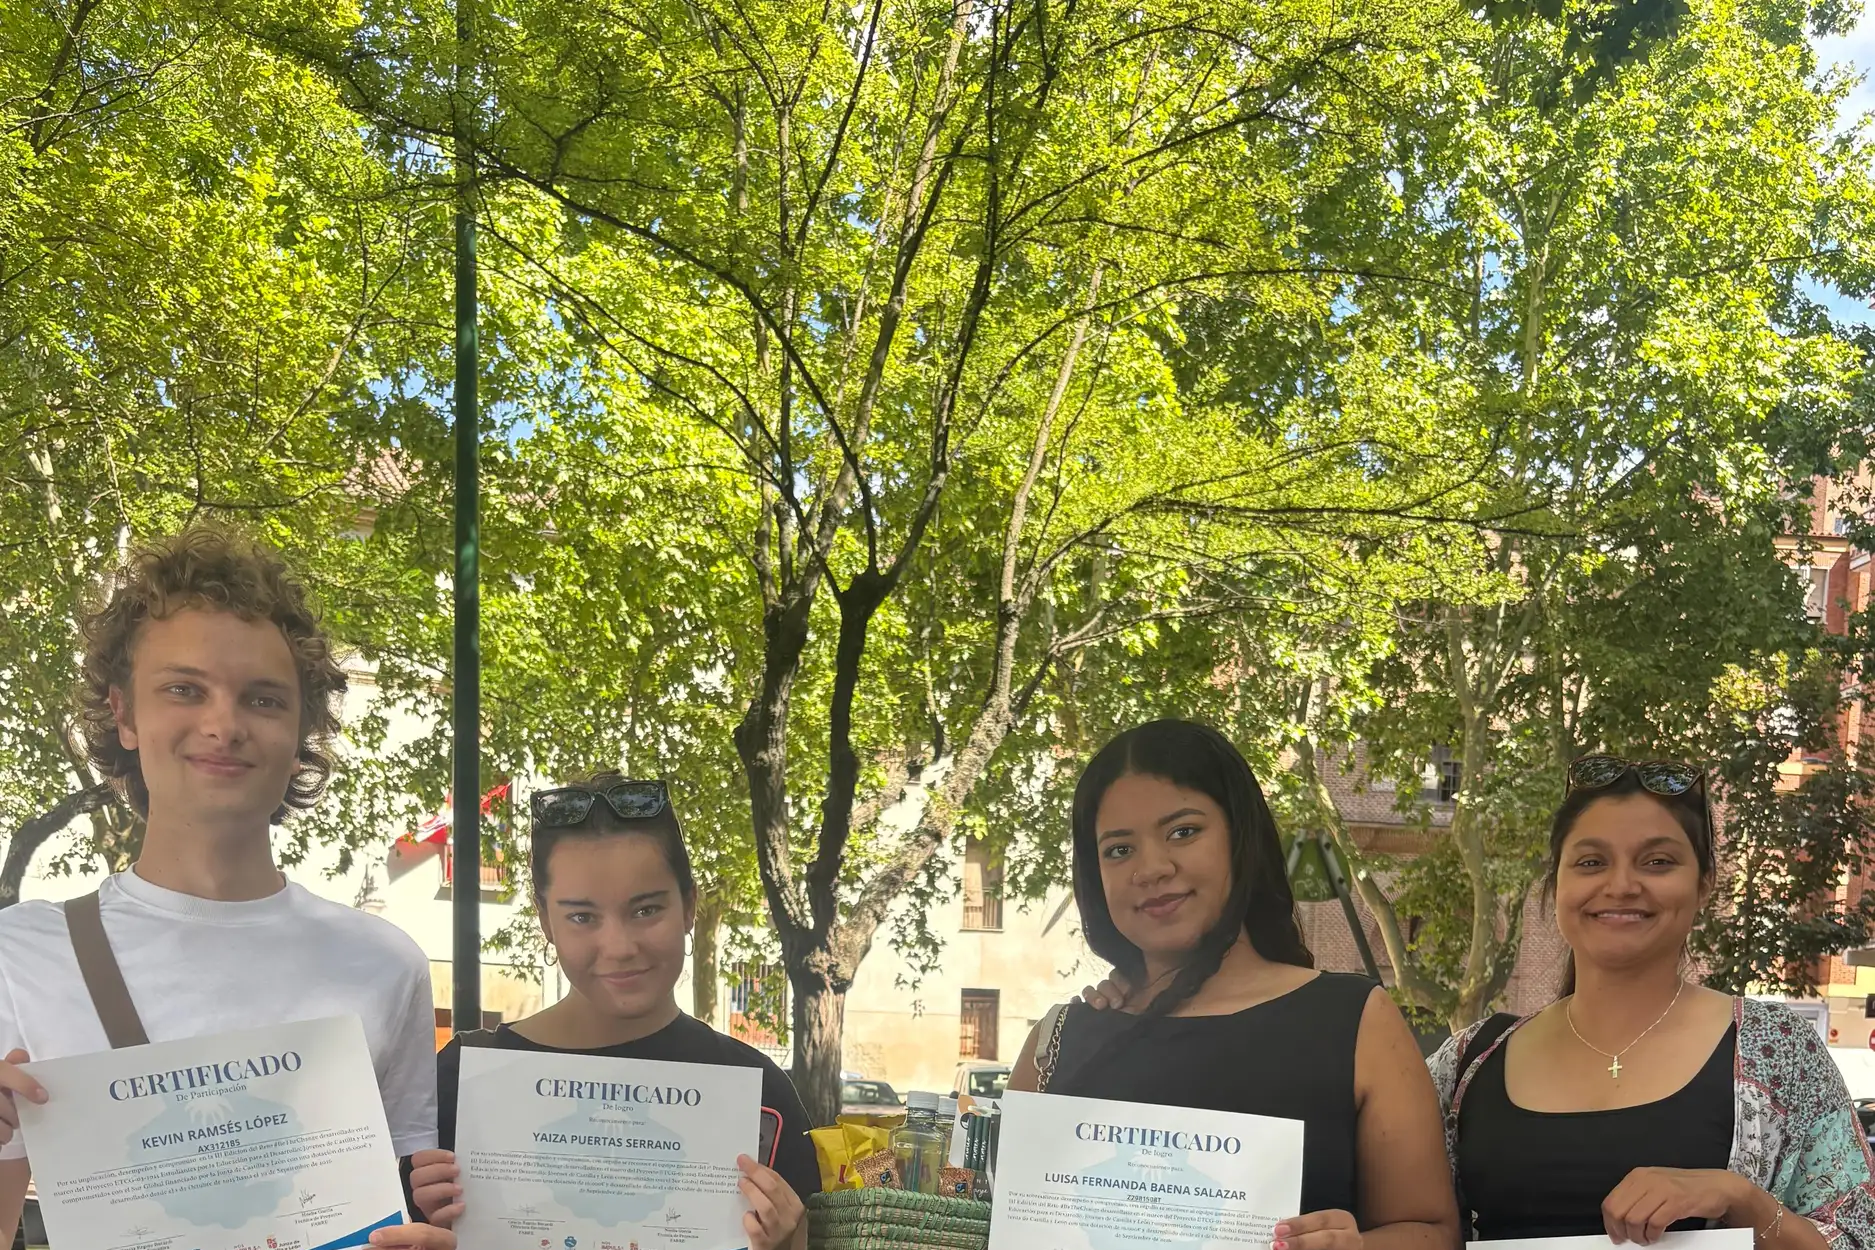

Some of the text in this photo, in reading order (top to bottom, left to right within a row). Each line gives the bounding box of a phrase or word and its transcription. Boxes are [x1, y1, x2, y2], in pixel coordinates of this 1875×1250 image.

[107, 1049, 303, 1102] CERTIFICADO
[175, 1081, 247, 1102] De Participación
[534, 1077, 701, 1107] CERTIFICADO
[614, 1104, 633, 1112] logro
[141, 1112, 288, 1149] KEVIN RAMSÉS LÓPEZ
[532, 1131, 681, 1151] YAIZA PUERTAS SERRANO
[1074, 1120, 1242, 1157] CERTIFICADO
[196, 1138, 241, 1153] AX312185
[1141, 1148, 1172, 1158] De logro
[1044, 1172, 1246, 1201] LUISA FERNANDA BAENA SALAZAR
